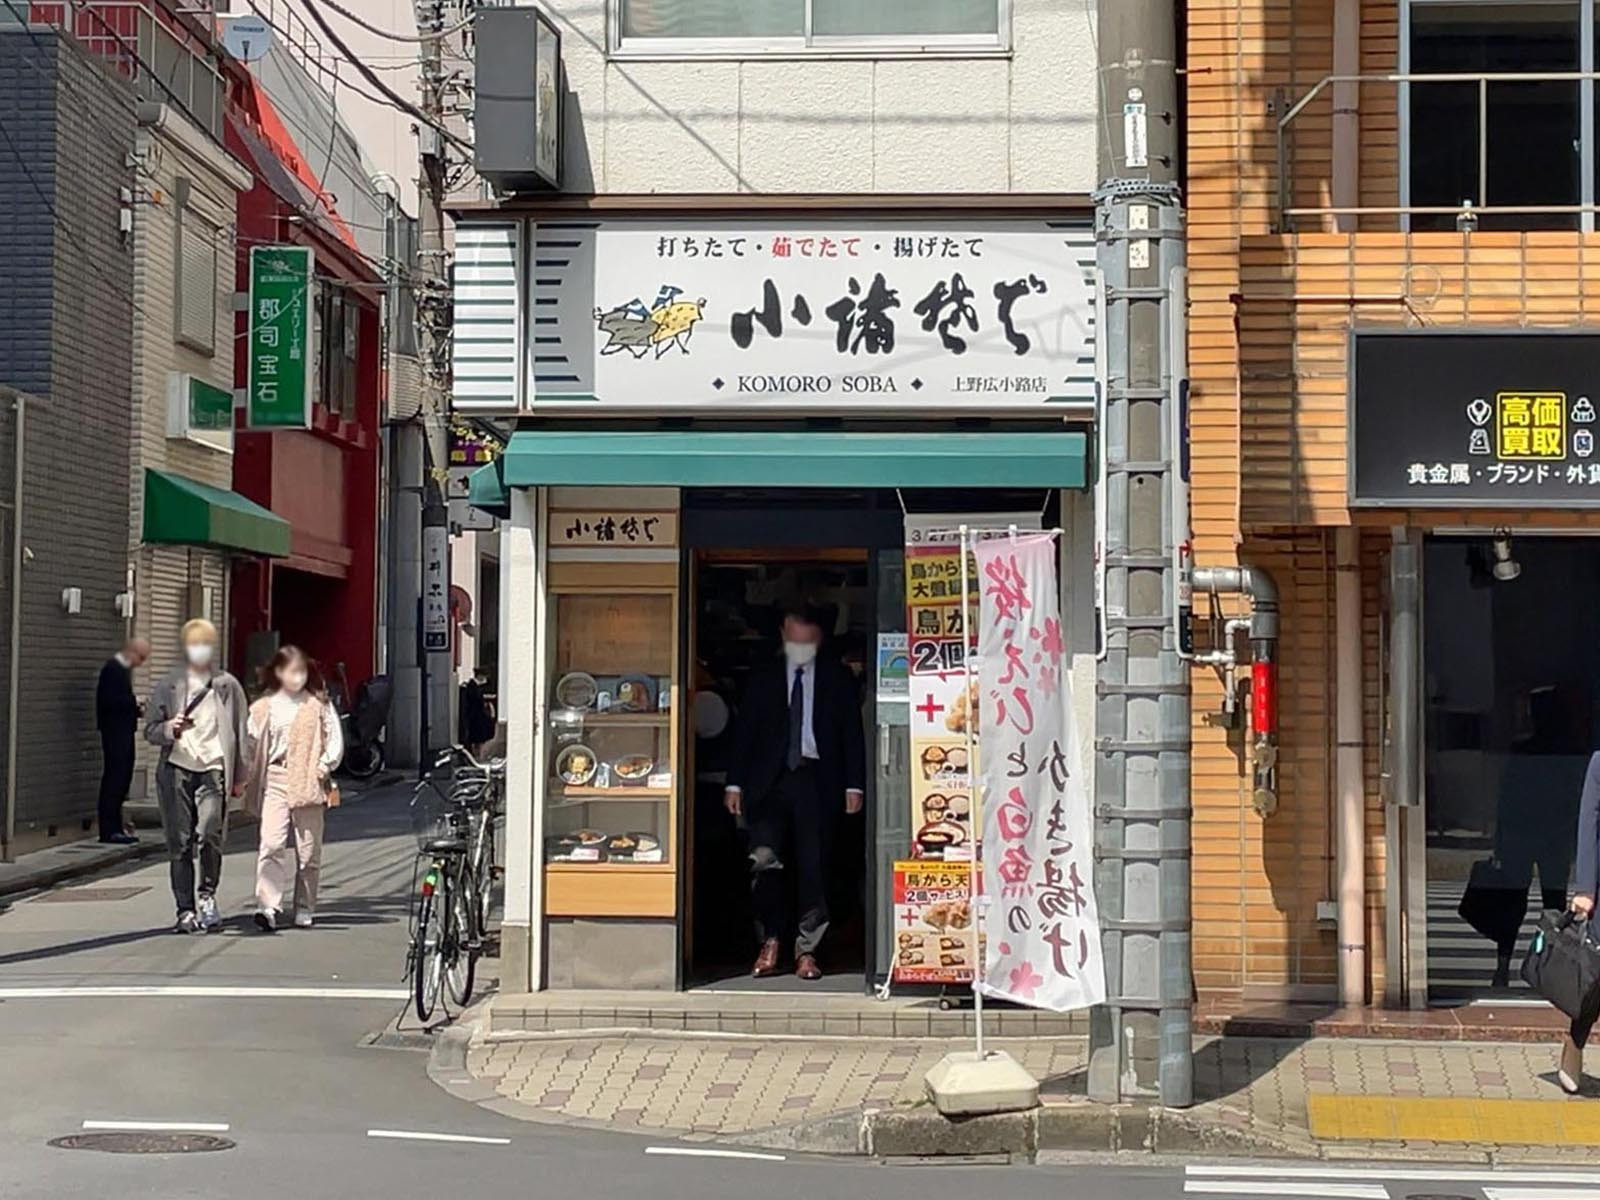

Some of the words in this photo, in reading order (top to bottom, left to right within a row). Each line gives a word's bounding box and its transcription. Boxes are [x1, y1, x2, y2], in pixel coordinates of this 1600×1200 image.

[257, 298, 281, 402] 郡司宝石
[738, 376, 832, 393] KOMORO
[842, 375, 898, 393] SOBA
[952, 376, 1048, 393] 上野広小路店
[1502, 397, 1562, 426] 高価
[1502, 427, 1562, 456] 買取
